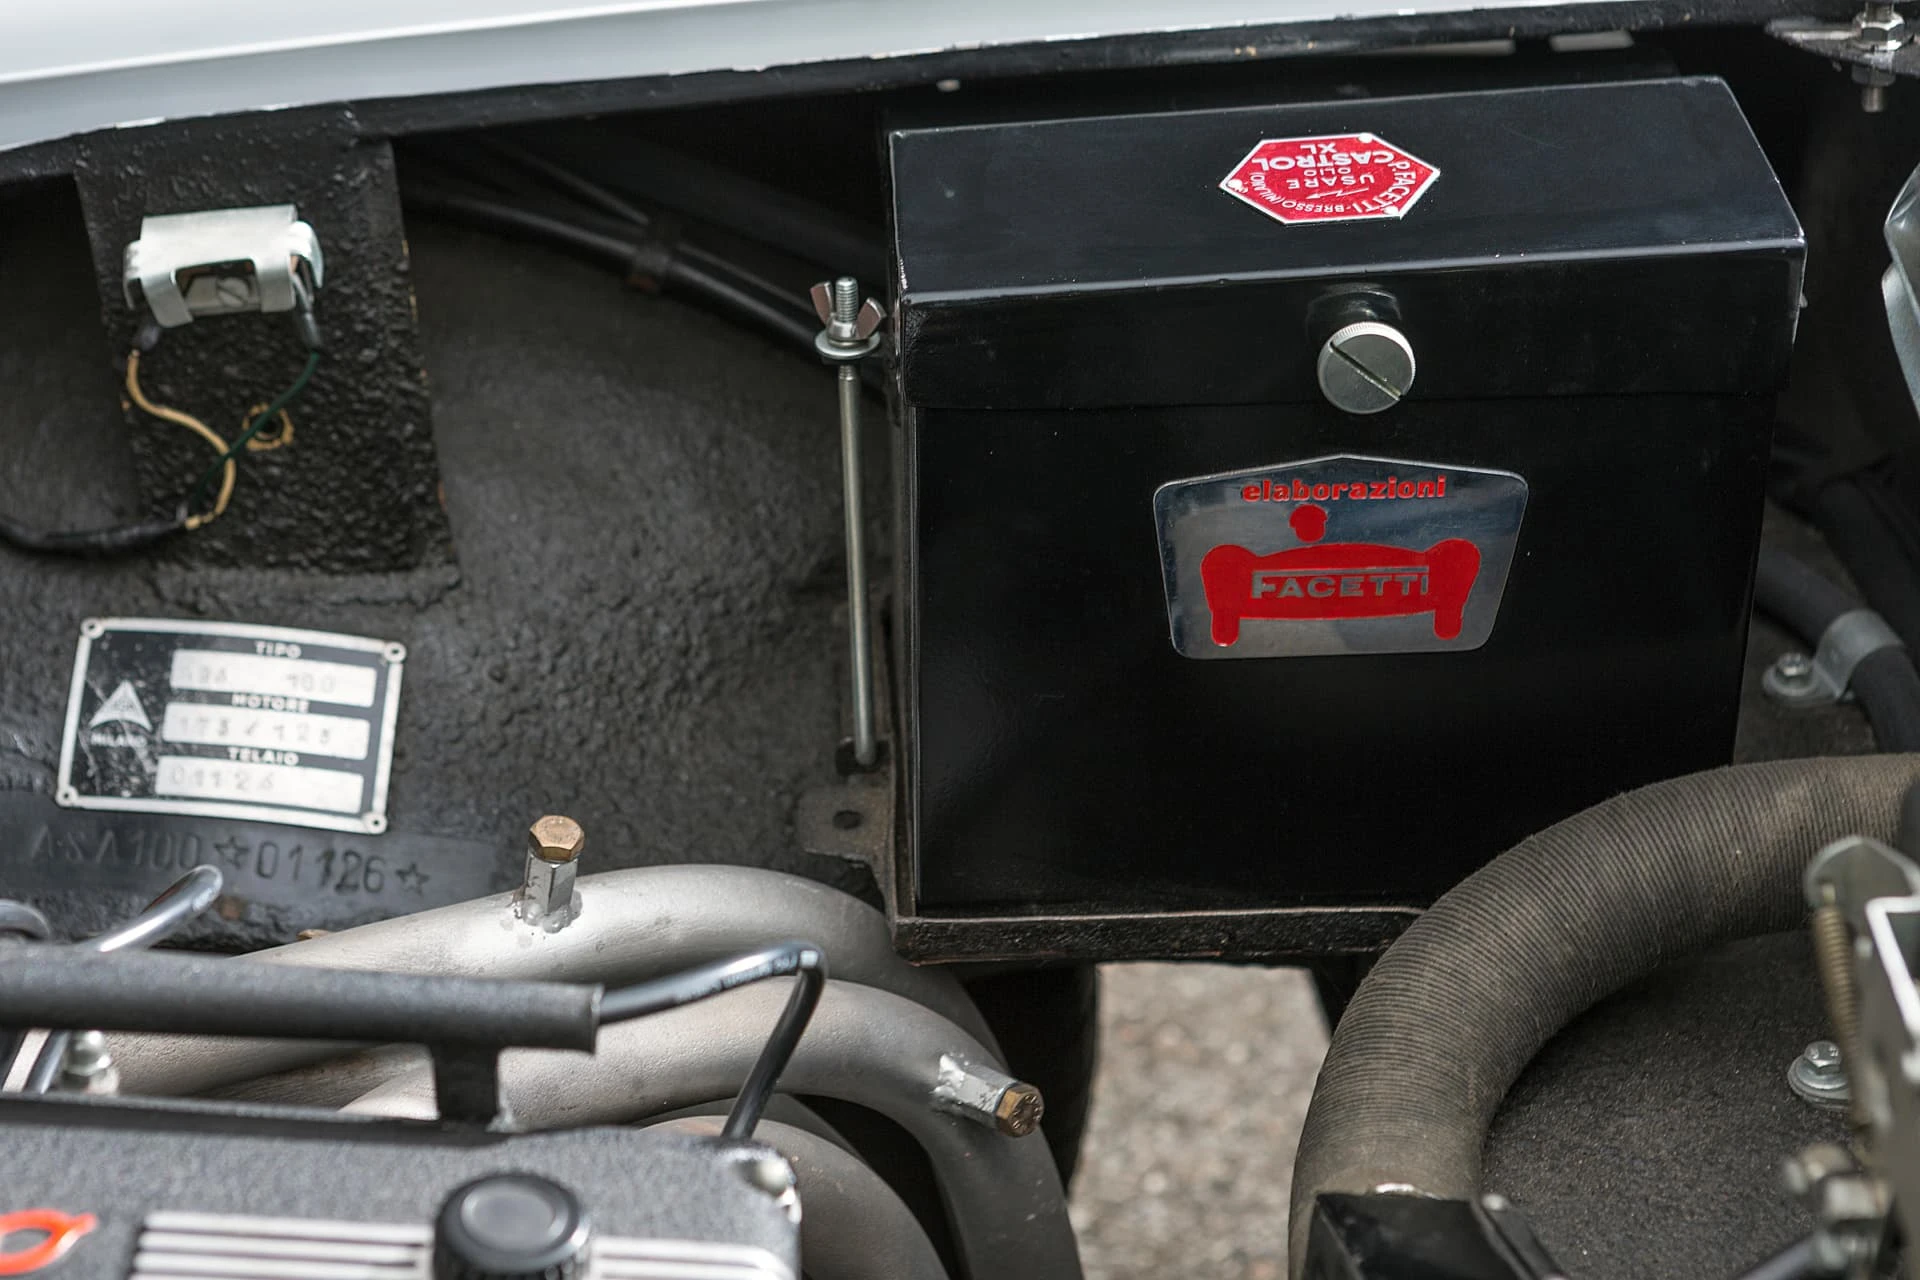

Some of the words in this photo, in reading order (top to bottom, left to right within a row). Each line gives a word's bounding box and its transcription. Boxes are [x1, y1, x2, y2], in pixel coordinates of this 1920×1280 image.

[1301, 142, 1337, 154] XL
[1251, 150, 1395, 171] CASTROL
[1286, 174, 1375, 190] USARE
[1304, 167, 1351, 178] OLIO
[1242, 475, 1446, 502] elaborazioni
[1251, 565, 1430, 599] FACETTI
[255, 641, 302, 659] TIPO
[231, 693, 310, 713] MOTORE
[228, 748, 300, 767] TELAIO
[257, 840, 386, 895] 01126
